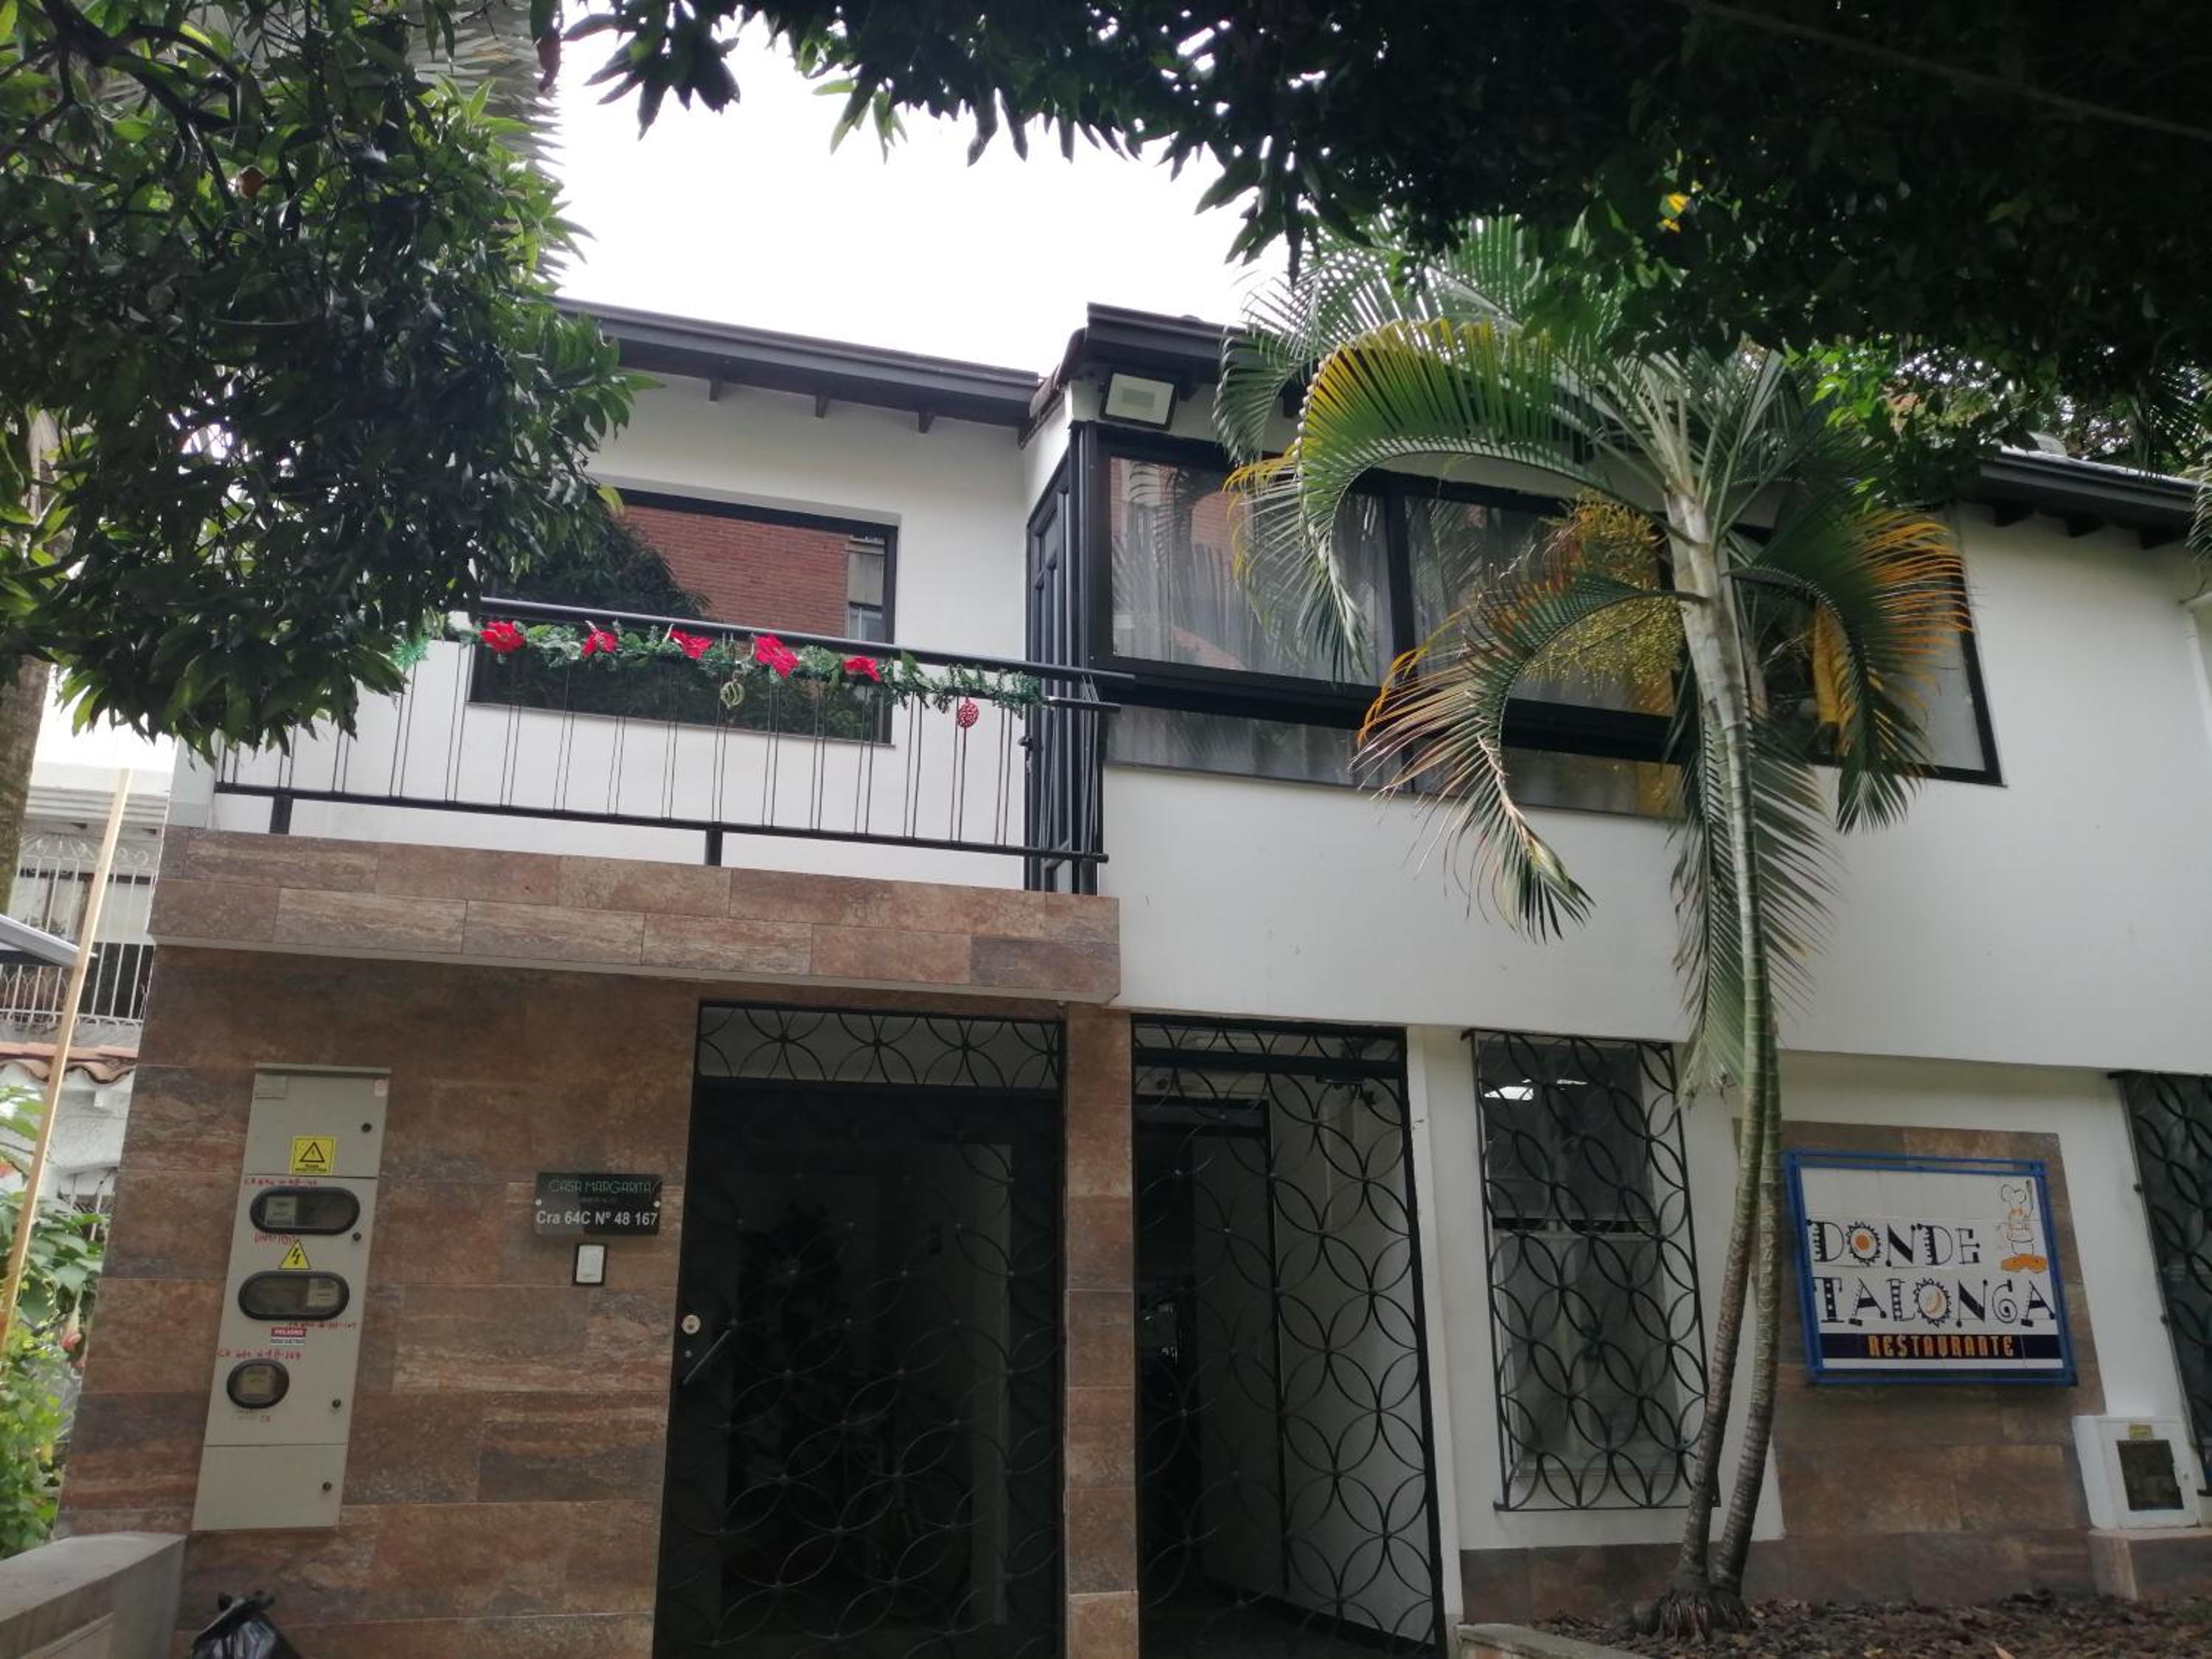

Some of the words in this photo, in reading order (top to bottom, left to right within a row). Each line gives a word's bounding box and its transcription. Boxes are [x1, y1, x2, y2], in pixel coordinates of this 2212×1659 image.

[548, 1180, 582, 1192] CASA
[585, 1180, 651, 1193] MARGARITA
[536, 1210, 560, 1225] Cra
[564, 1211, 591, 1225] 64C
[614, 1211, 630, 1225] 48
[635, 1211, 658, 1225] 167
[1806, 1218, 1981, 1267] DONDE
[1811, 1276, 2056, 1328] TALONGA
[1867, 1334, 2014, 1358] RESTAURANTE
